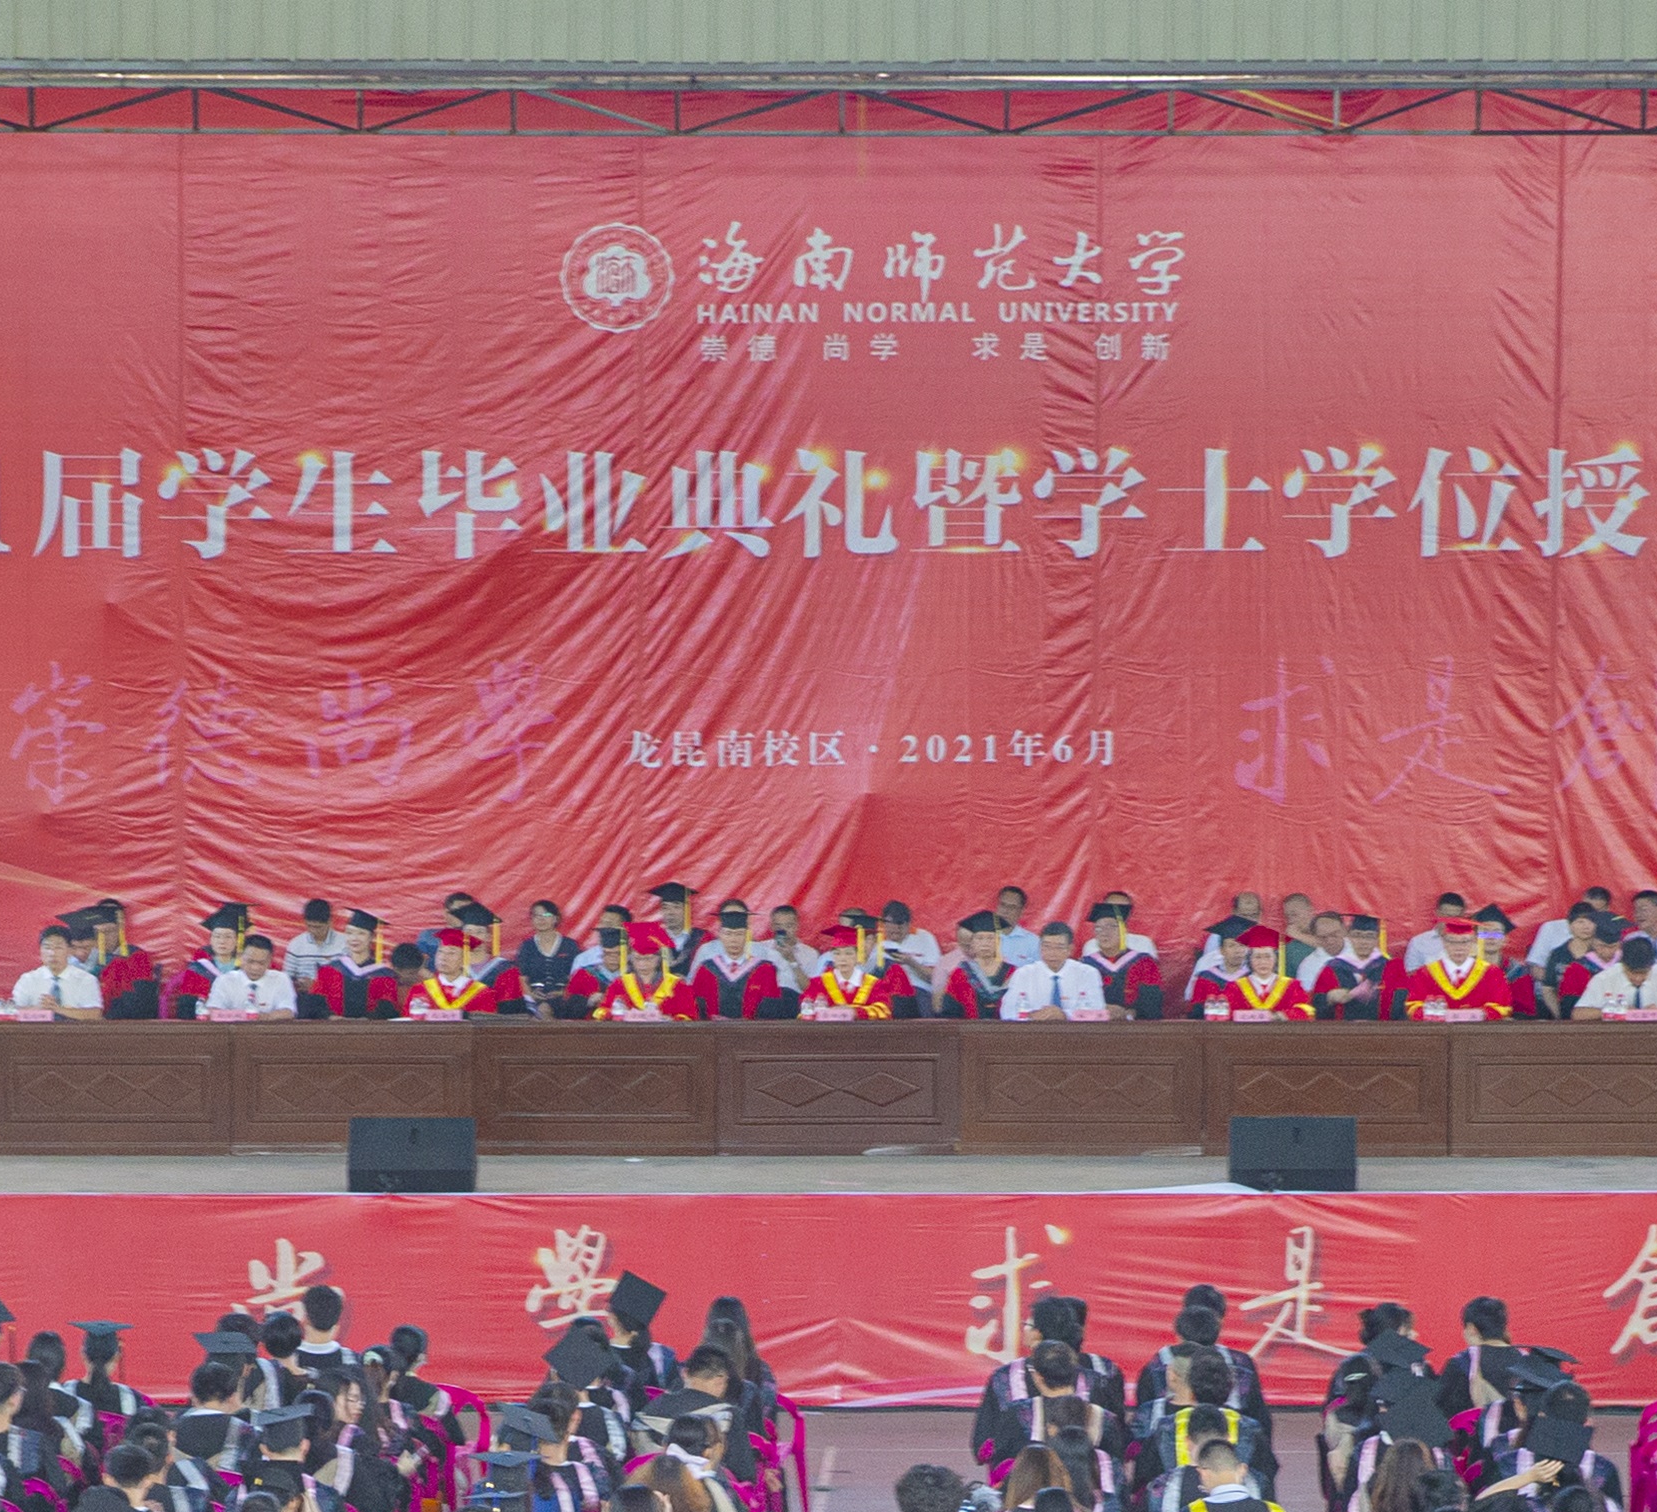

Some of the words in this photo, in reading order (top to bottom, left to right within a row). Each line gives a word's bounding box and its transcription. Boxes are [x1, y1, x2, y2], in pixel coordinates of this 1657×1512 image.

[698, 221, 1185, 300] 海南师范大学
[696, 302, 820, 324] HAINAN
[843, 302, 975, 324] NORMAL
[998, 301, 1180, 323] UNIVERSITY
[699, 333, 777, 363] 崇德
[823, 333, 899, 362] 尚学
[972, 333, 1049, 362] 求是
[1094, 332, 1171, 362] 创新
